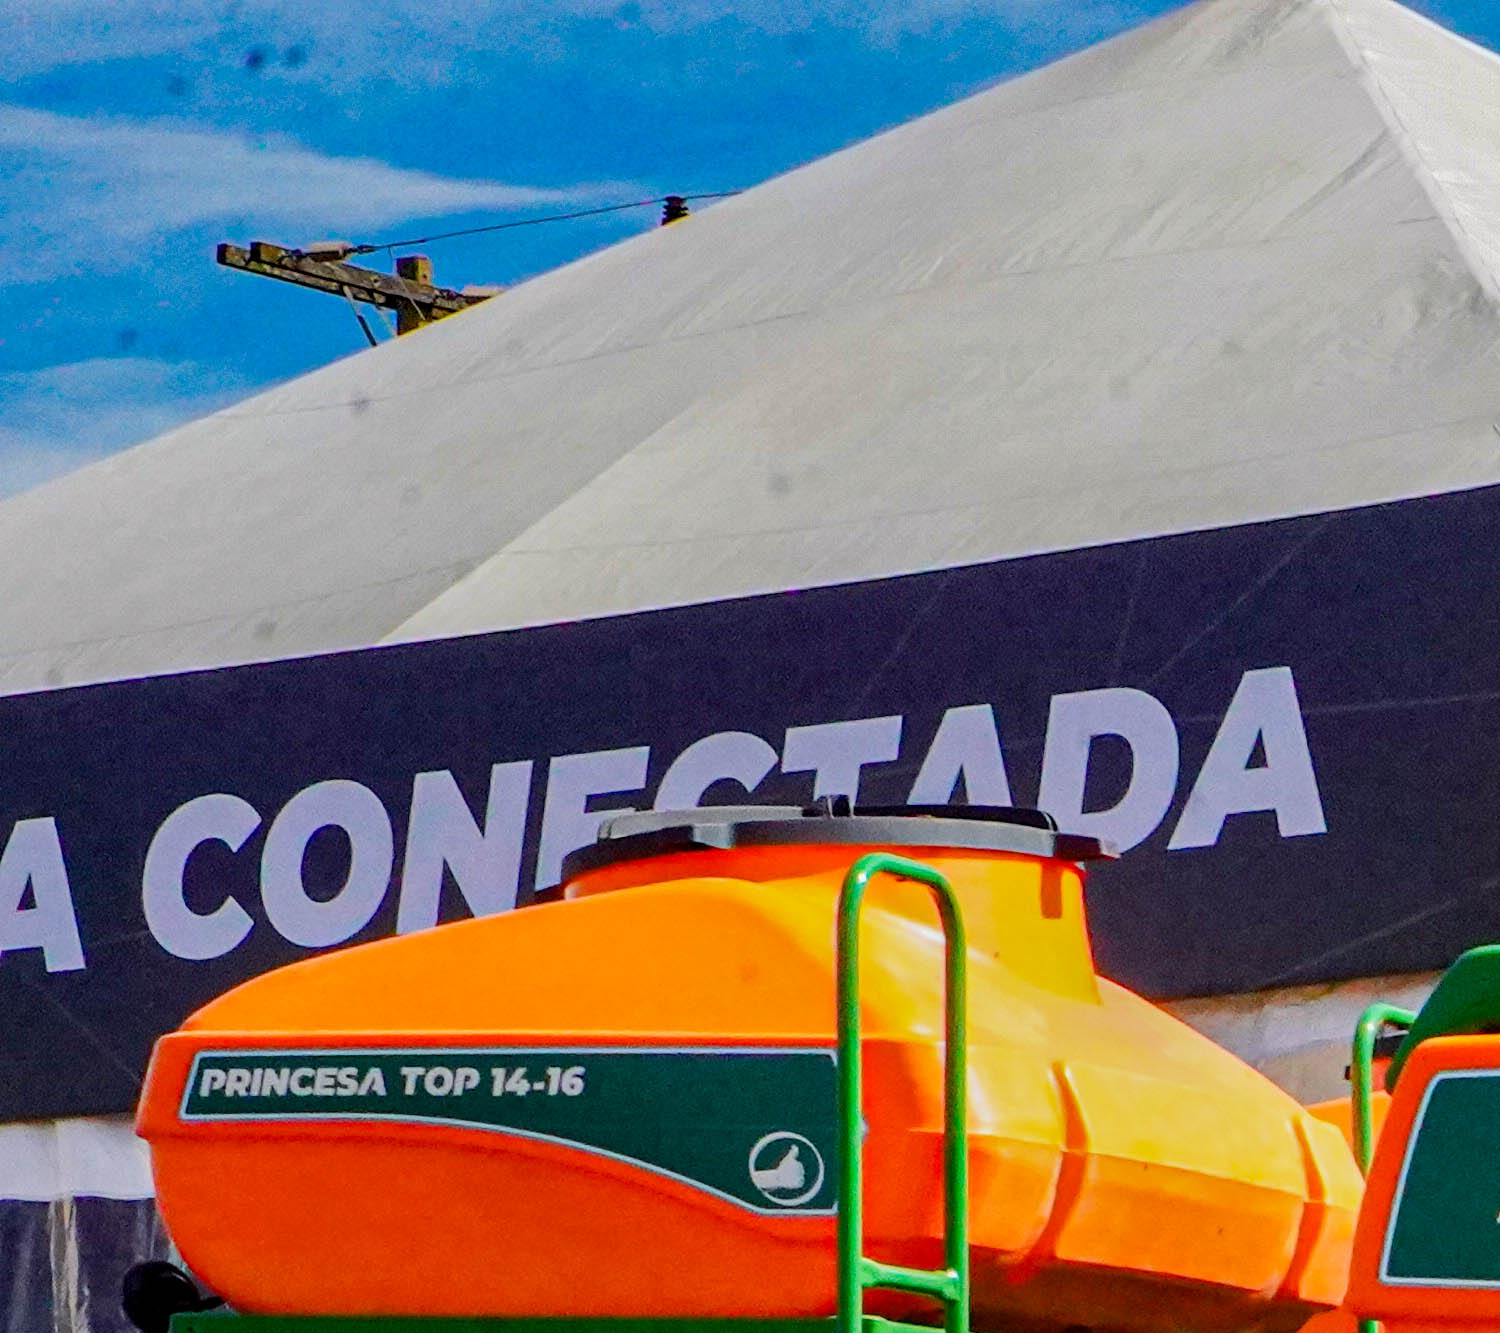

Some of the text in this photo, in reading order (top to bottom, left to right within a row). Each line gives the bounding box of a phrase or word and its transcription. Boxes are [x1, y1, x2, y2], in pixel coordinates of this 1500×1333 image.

[199, 1064, 587, 1100] PRINCESA TOP 14-16
